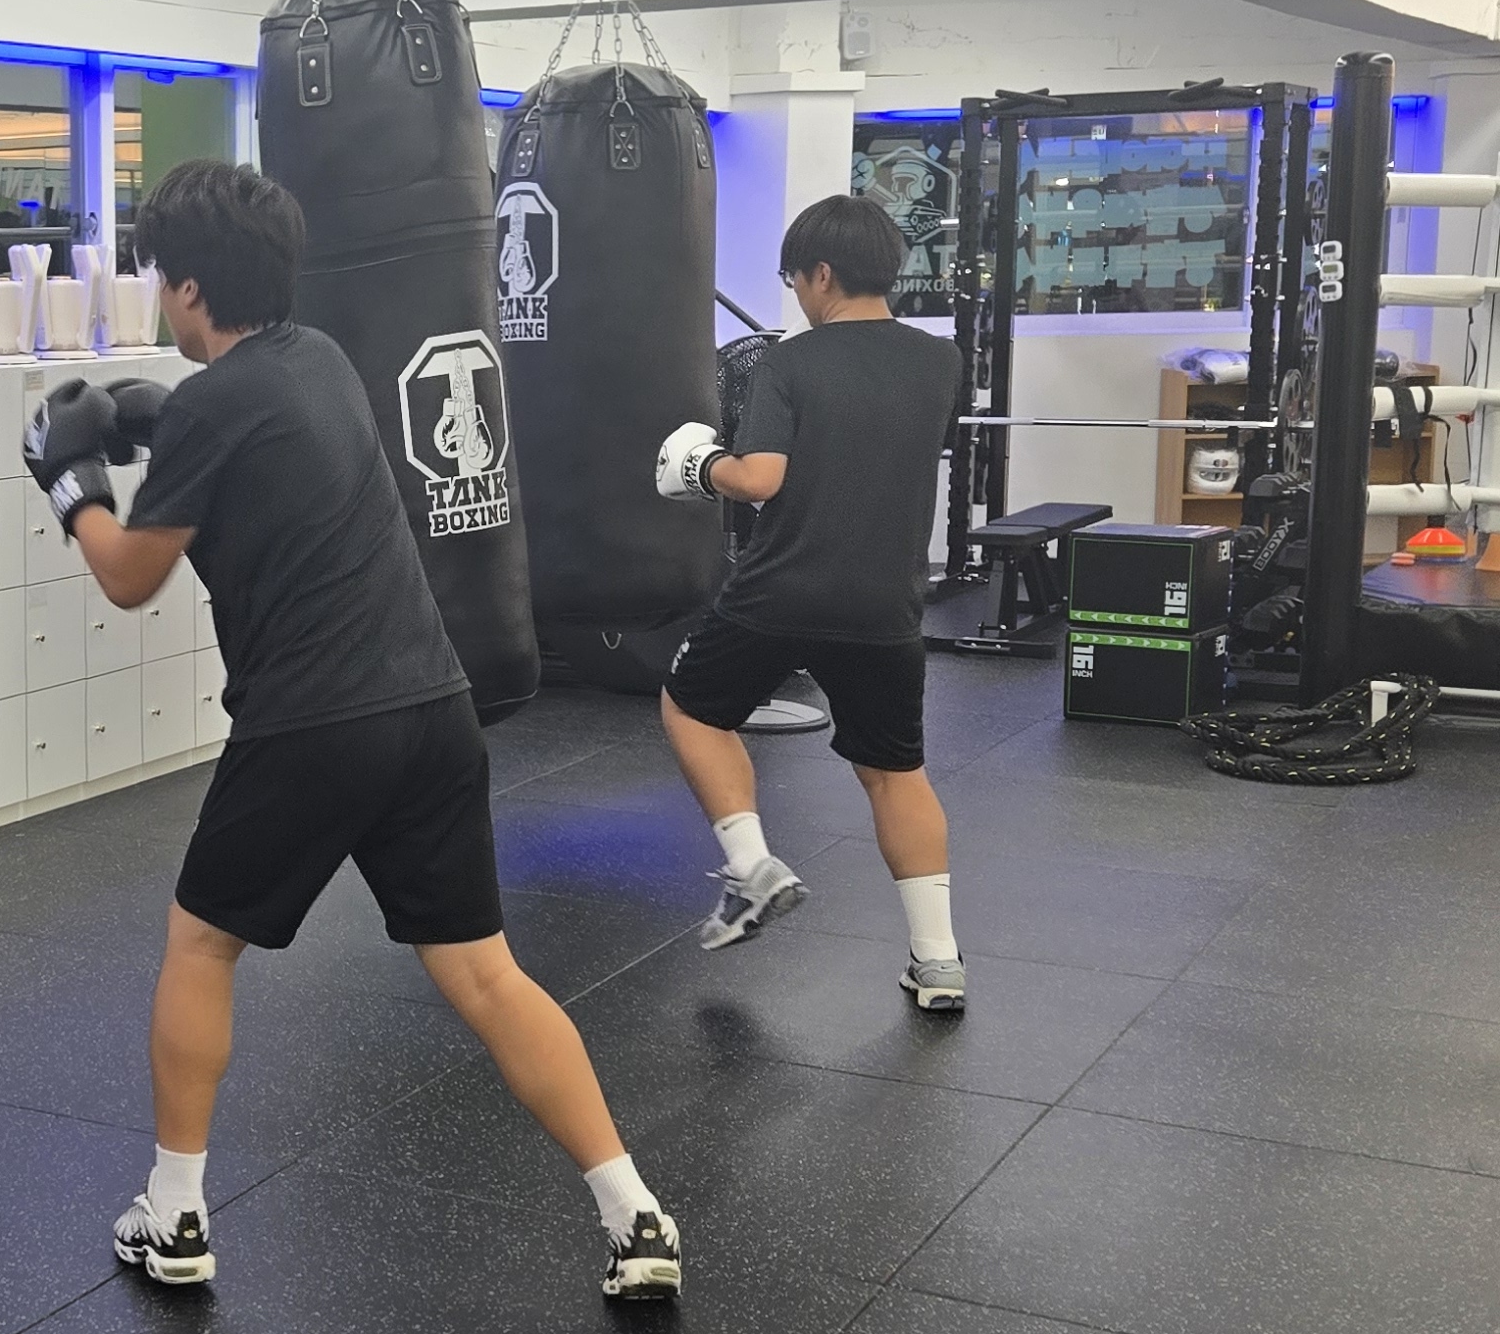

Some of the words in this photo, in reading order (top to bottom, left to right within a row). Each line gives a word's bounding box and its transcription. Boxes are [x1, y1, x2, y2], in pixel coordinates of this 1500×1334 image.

[428, 471, 507, 509] TANK
[431, 502, 509, 534] BOXING
[1164, 581, 1187, 590] INCH
[1164, 590, 1187, 616] 16
[1072, 645, 1095, 670] 16
[1072, 670, 1094, 678] INCH
